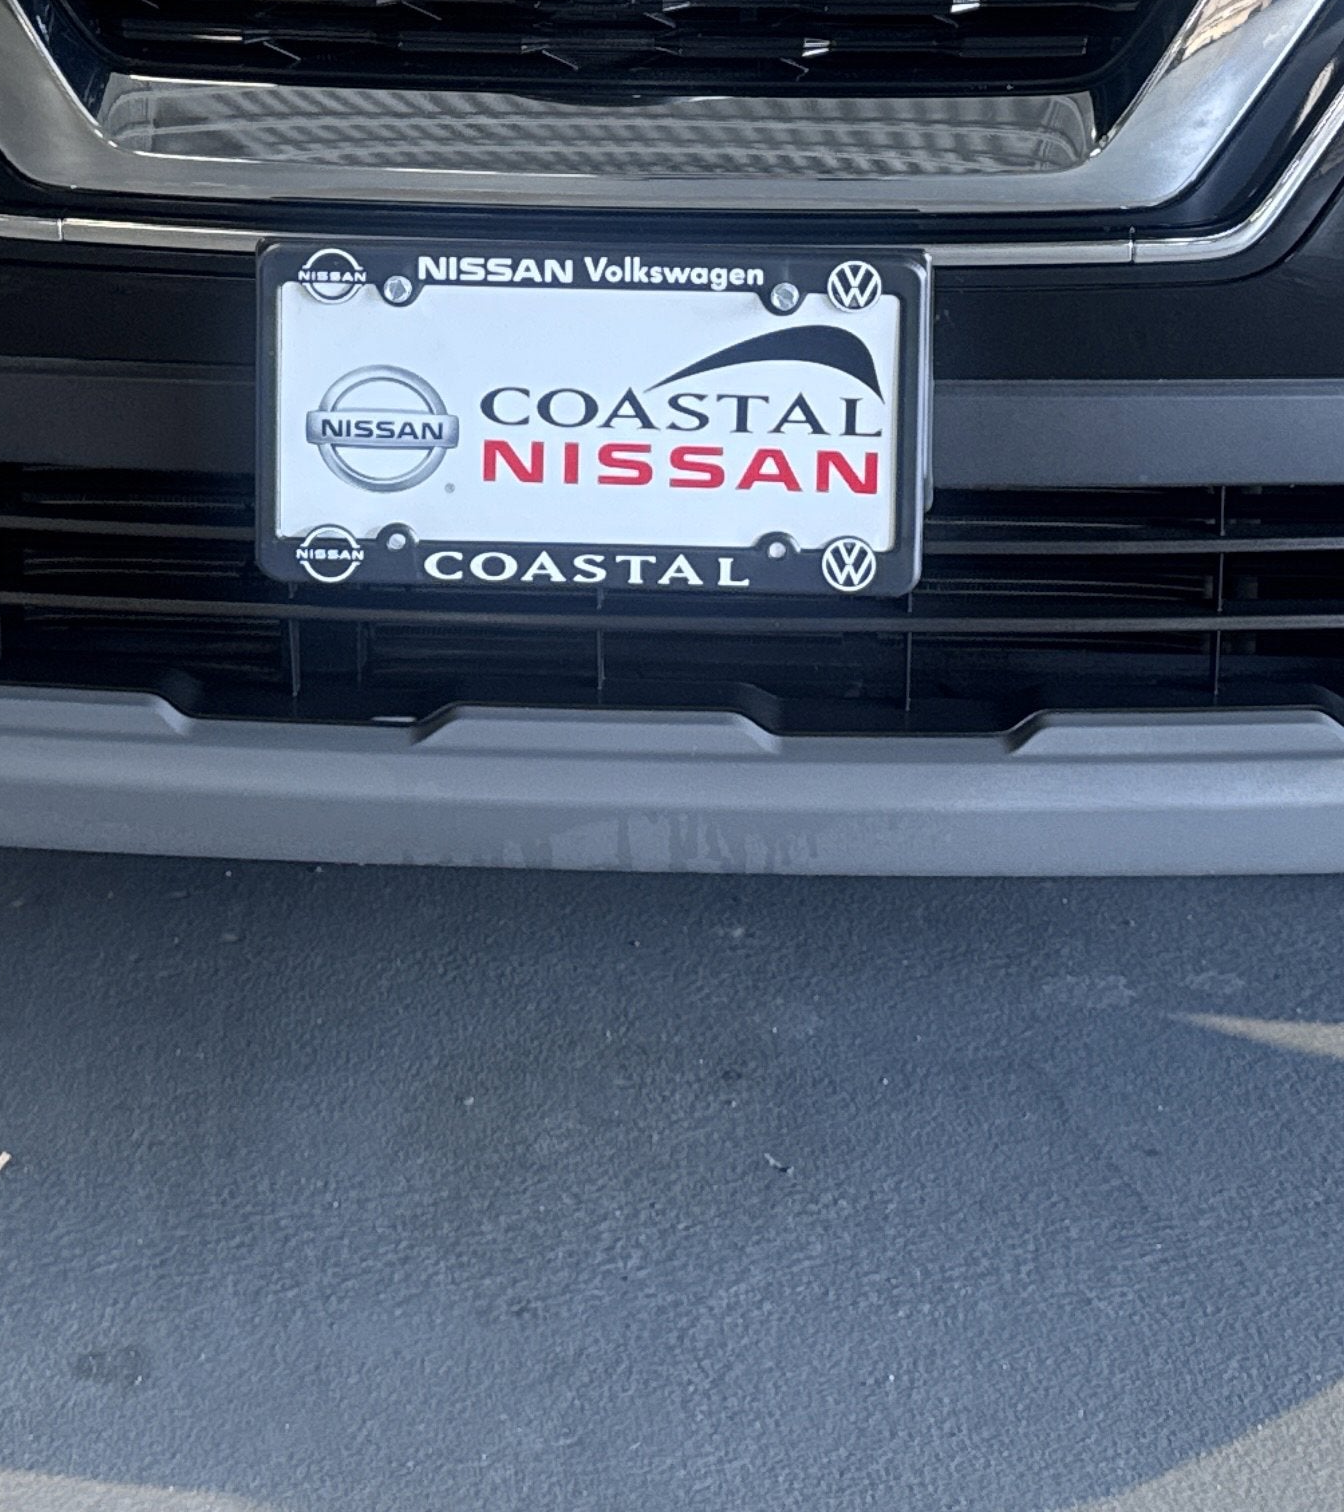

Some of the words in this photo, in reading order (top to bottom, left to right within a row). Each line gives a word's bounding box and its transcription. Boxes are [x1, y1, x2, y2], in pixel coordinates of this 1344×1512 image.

[298, 270, 367, 283] NISSAN
[418, 256, 574, 283] NISSAN
[583, 256, 764, 290] Volkswagen
[480, 386, 884, 438] COASTAL
[321, 418, 444, 441] NISSAN
[482, 439, 879, 495] NISSAN
[296, 548, 365, 561] NISSAN
[423, 550, 750, 587] COASTAL
